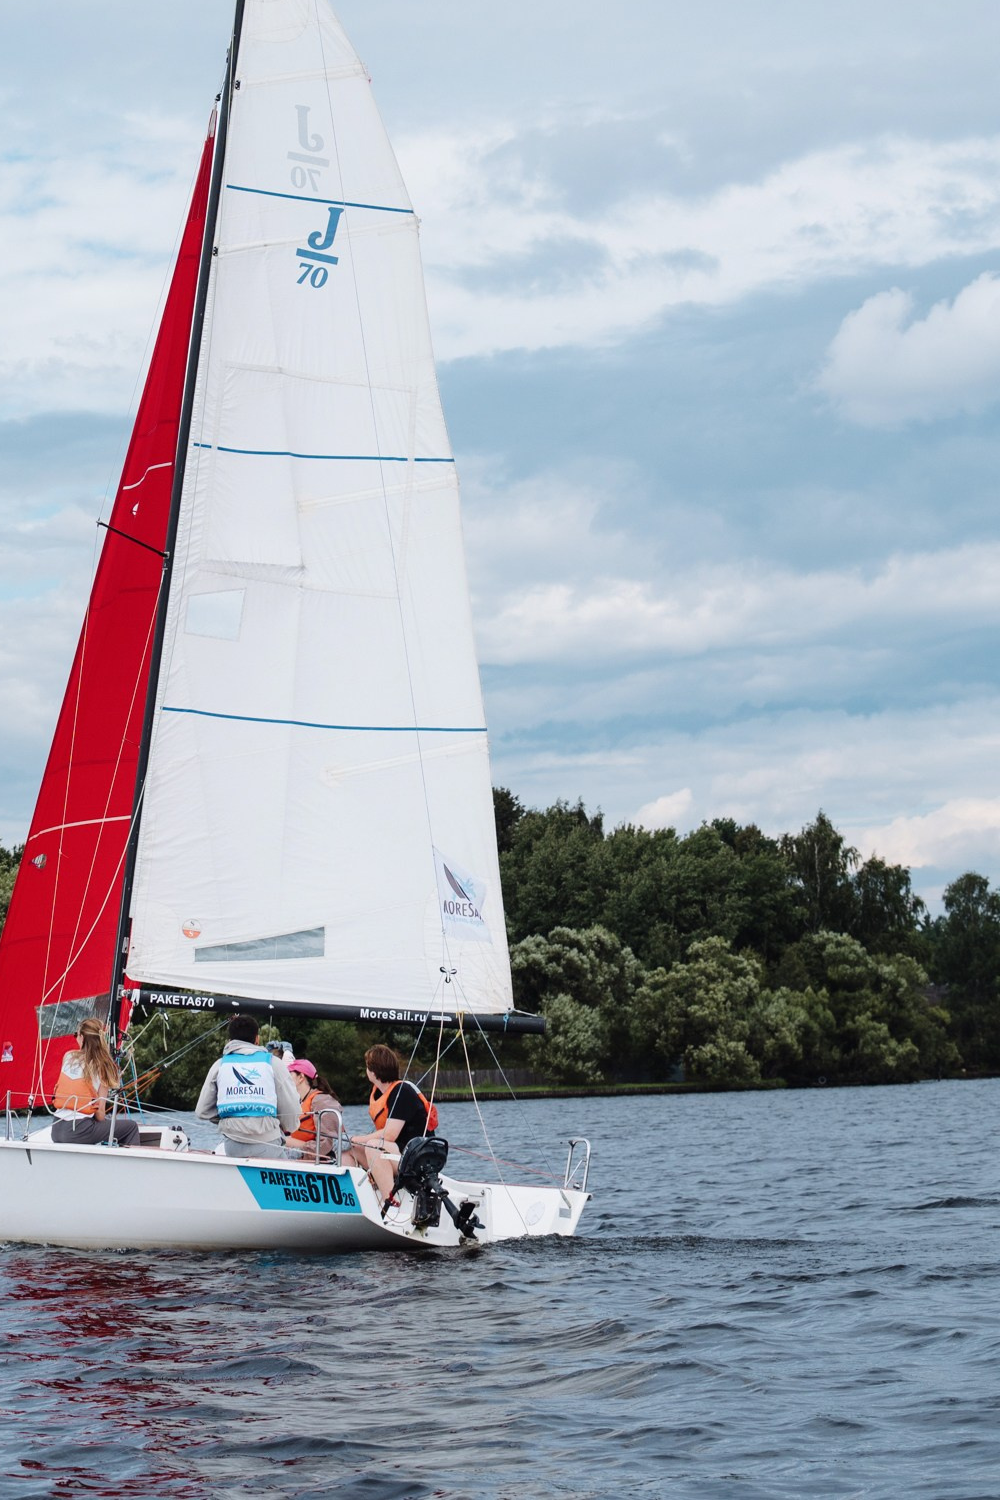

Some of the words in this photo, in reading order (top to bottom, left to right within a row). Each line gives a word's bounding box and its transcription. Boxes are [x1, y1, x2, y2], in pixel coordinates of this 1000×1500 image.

[307, 206, 344, 251] J
[296, 262, 329, 289] 70
[360, 1008, 427, 1022] MoreSail.ru
[284, 1188, 310, 1203] RUS
[305, 1172, 343, 1205] 670
[343, 1193, 356, 1207] 26
